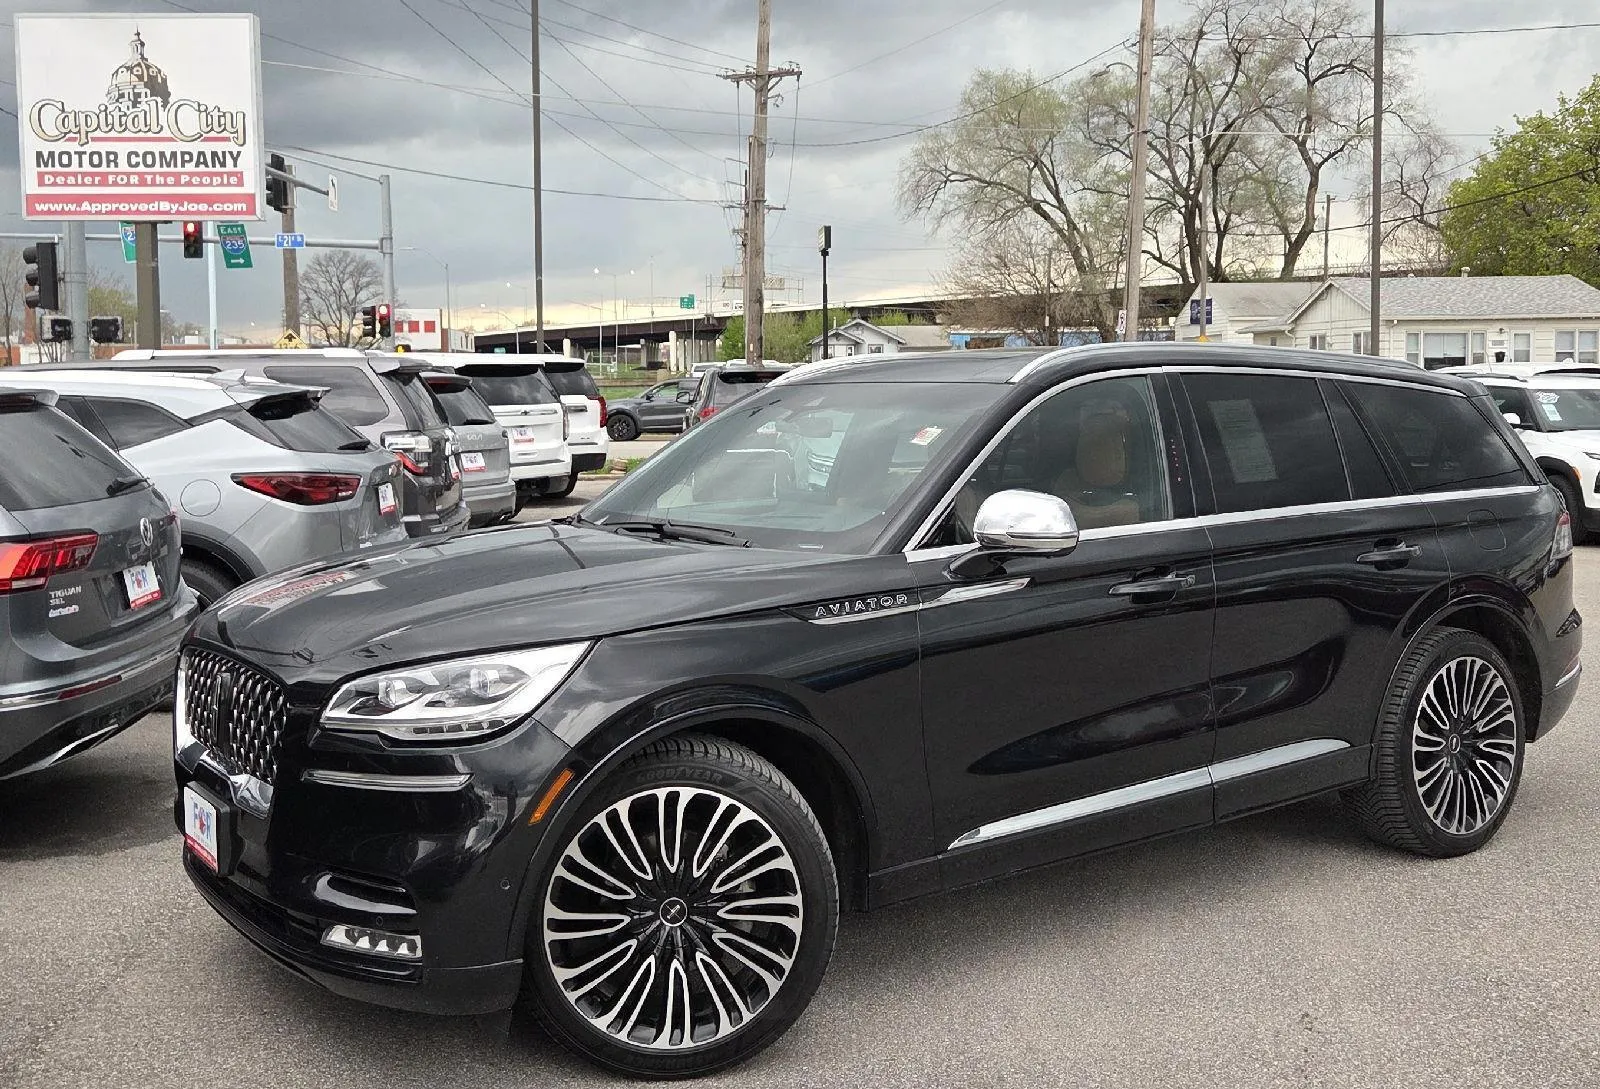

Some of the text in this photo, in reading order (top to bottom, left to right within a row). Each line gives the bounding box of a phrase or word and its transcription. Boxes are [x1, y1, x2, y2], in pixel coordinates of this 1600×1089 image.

[29, 98, 246, 146] Capital City
[35, 150, 242, 169] MOTOR COMPANY
[44, 173, 102, 185] Dealer
[108, 173, 140, 185] FOR
[144, 173, 175, 185] The
[34, 200, 247, 214] www.ApprovedByJoe.com
[225, 239, 245, 249] 235
[49, 585, 82, 598] TIGUAN
[49, 598, 65, 606] SEL
[815, 593, 908, 617] AVIATOR
